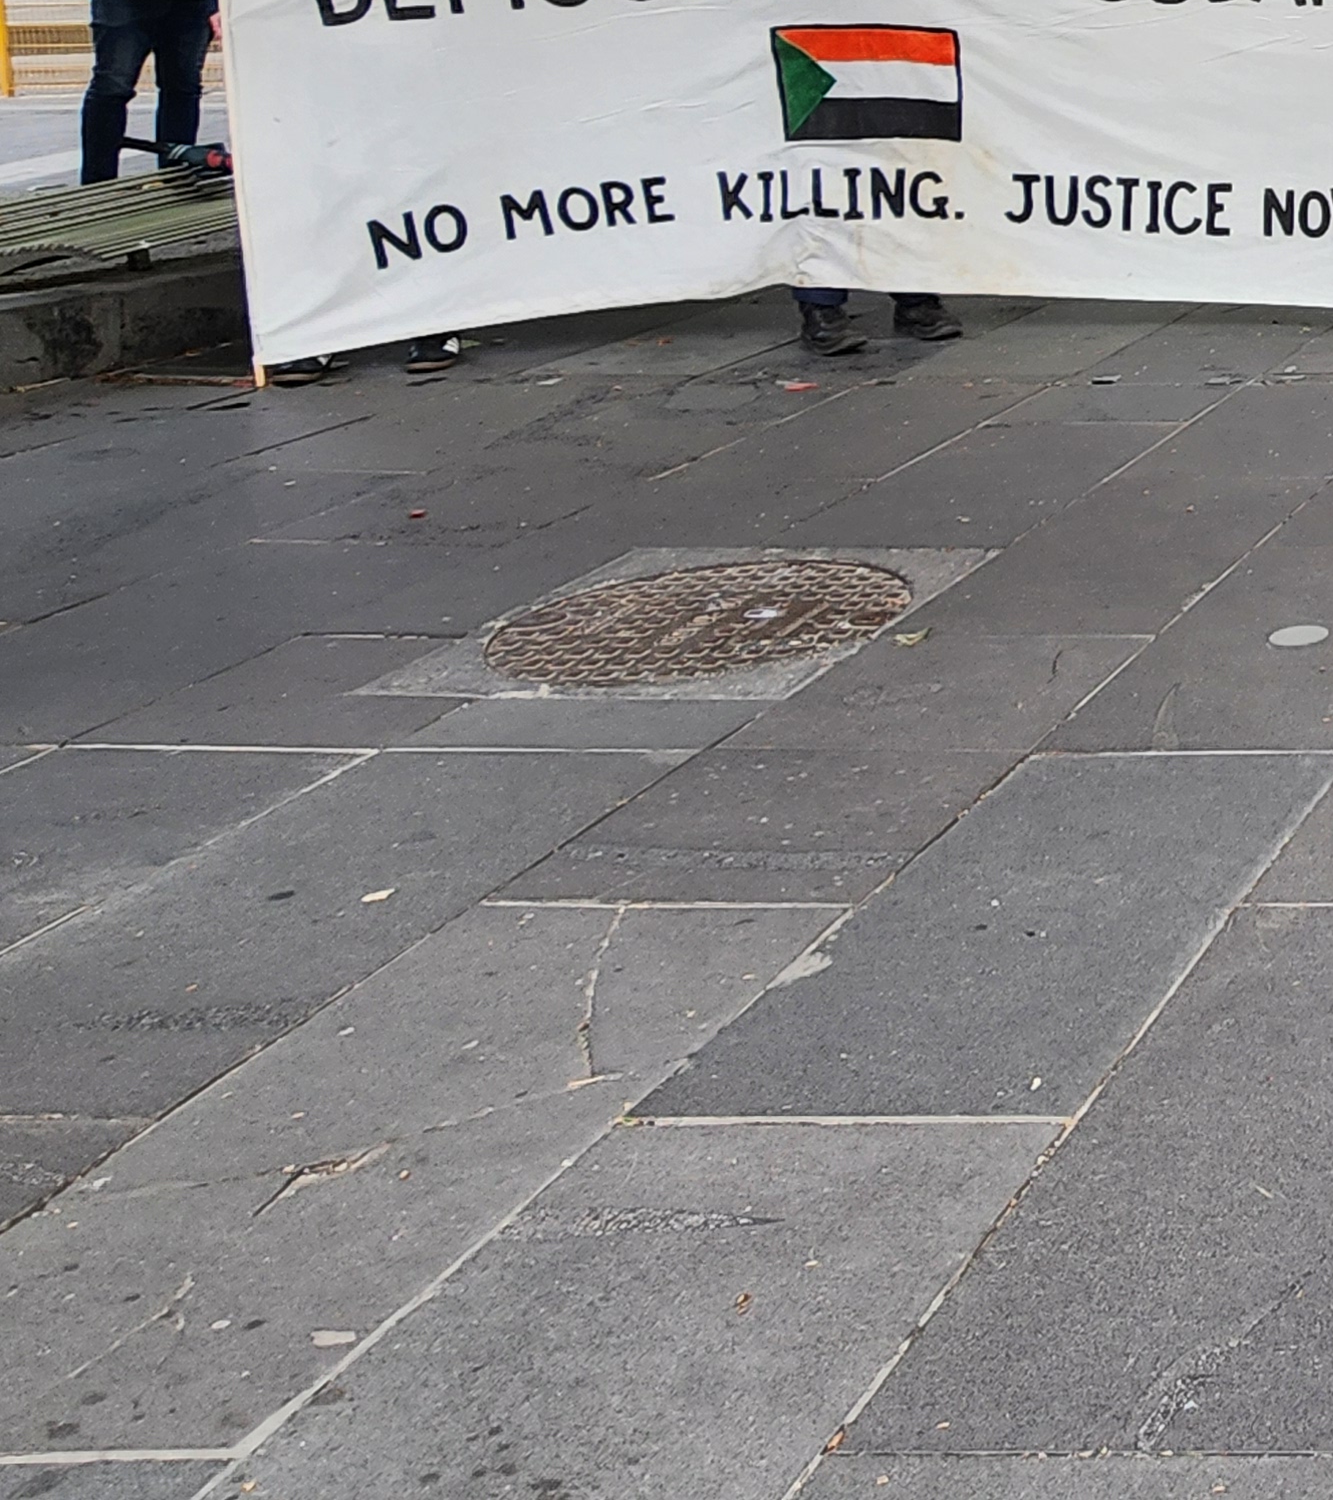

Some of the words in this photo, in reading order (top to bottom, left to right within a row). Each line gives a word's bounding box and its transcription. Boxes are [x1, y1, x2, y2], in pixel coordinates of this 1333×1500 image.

[366, 203, 468, 270] NO
[500, 175, 676, 241] MORE
[717, 167, 965, 223] KILLING.
[1005, 173, 1232, 237] JUSTICE
